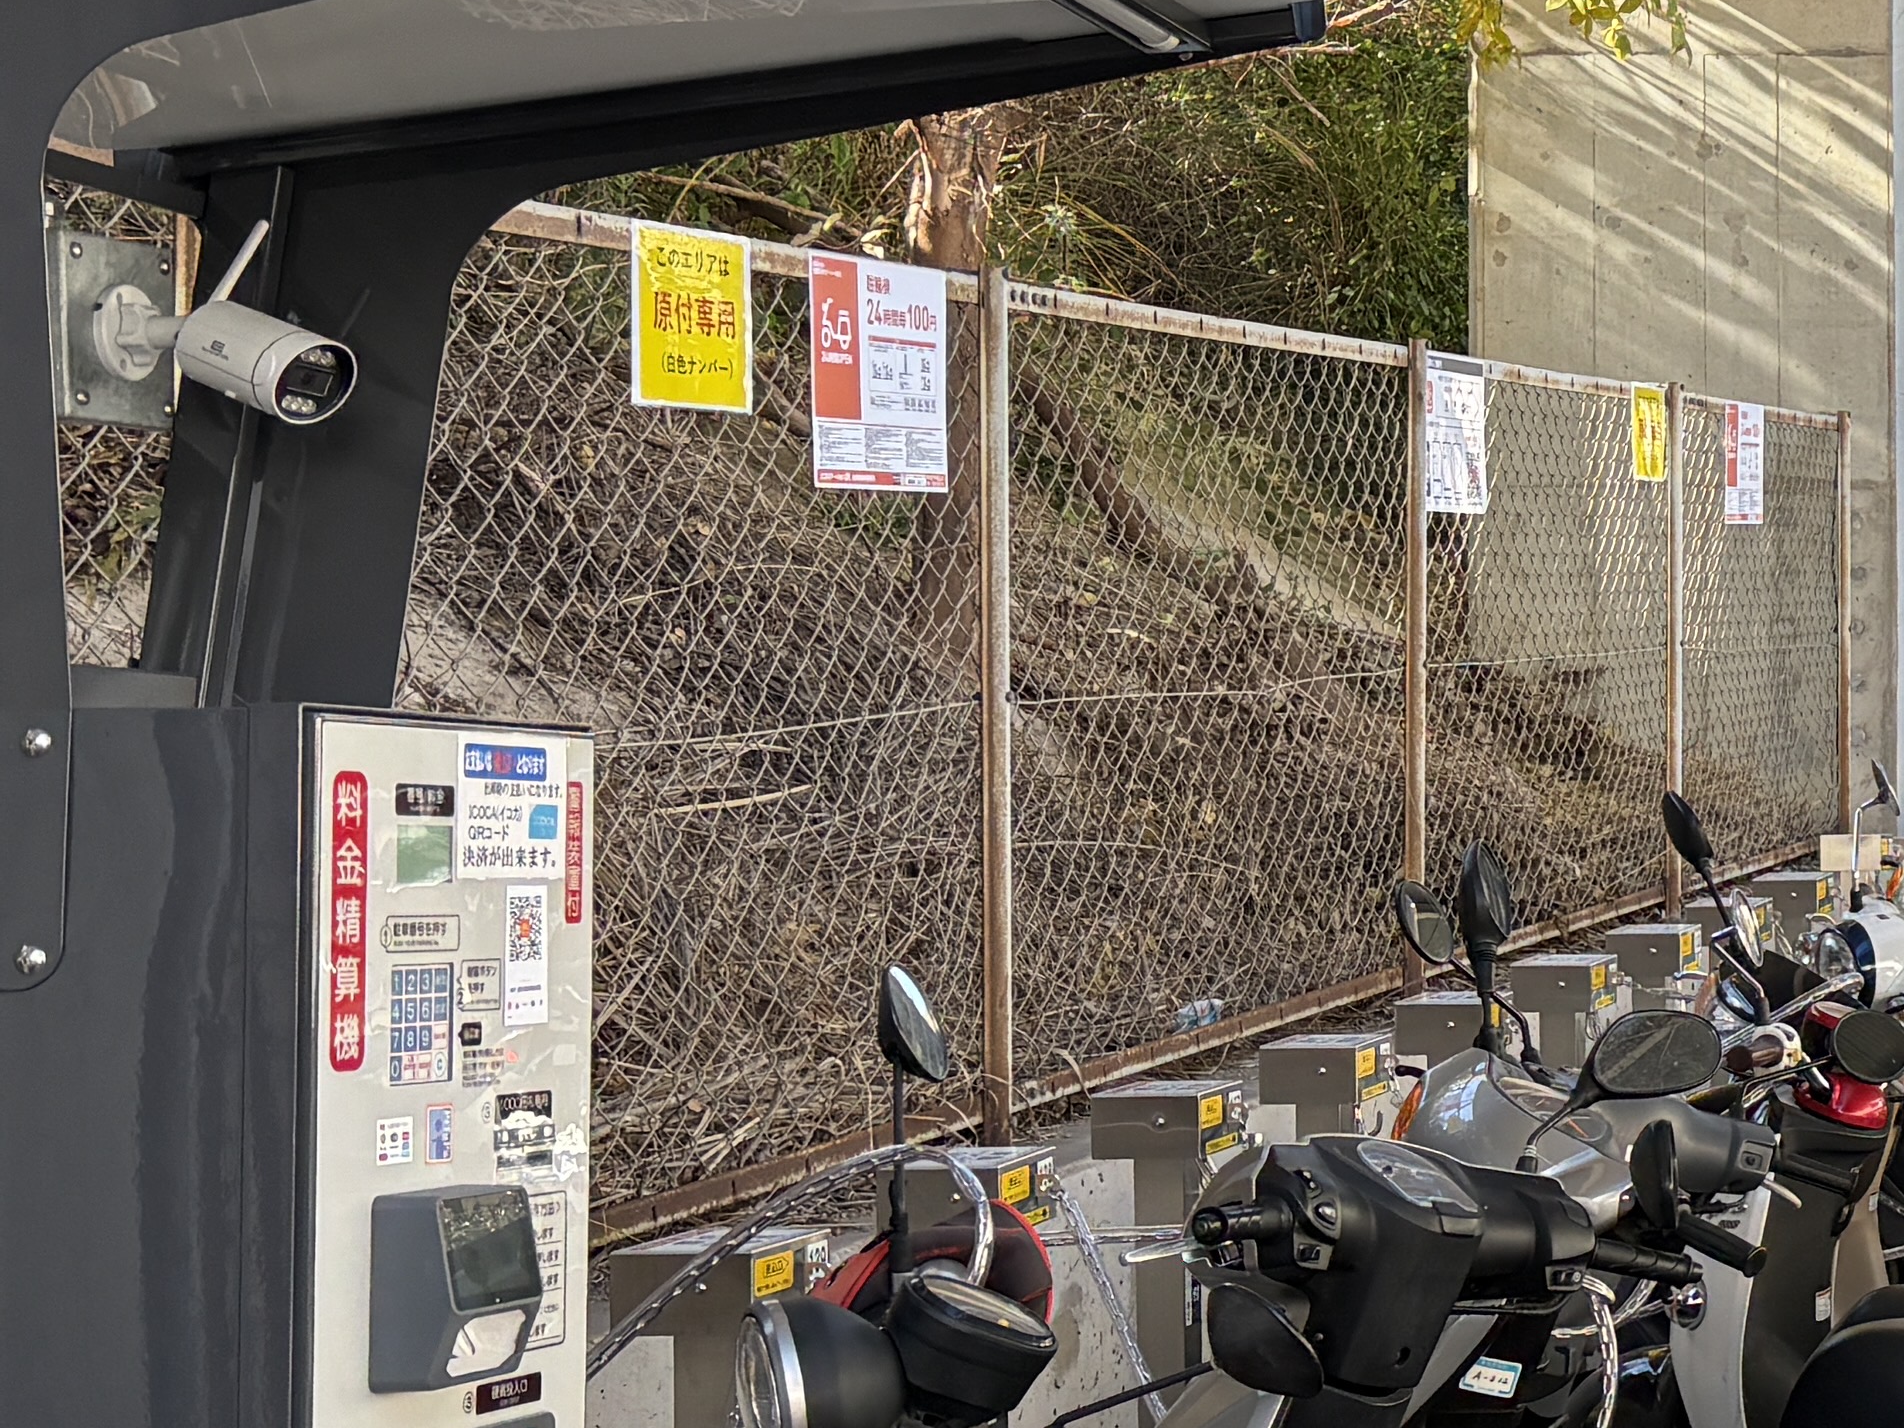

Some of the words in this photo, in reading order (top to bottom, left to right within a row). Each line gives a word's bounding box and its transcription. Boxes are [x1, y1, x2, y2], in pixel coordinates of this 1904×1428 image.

[656, 245, 730, 277] このエリアは
[653, 291, 736, 340] 原付専用
[662, 351, 733, 380] (白色ナンバー)
[463, 845, 556, 868] 決済が出来ます。
[334, 779, 365, 1063] 料金精算機
